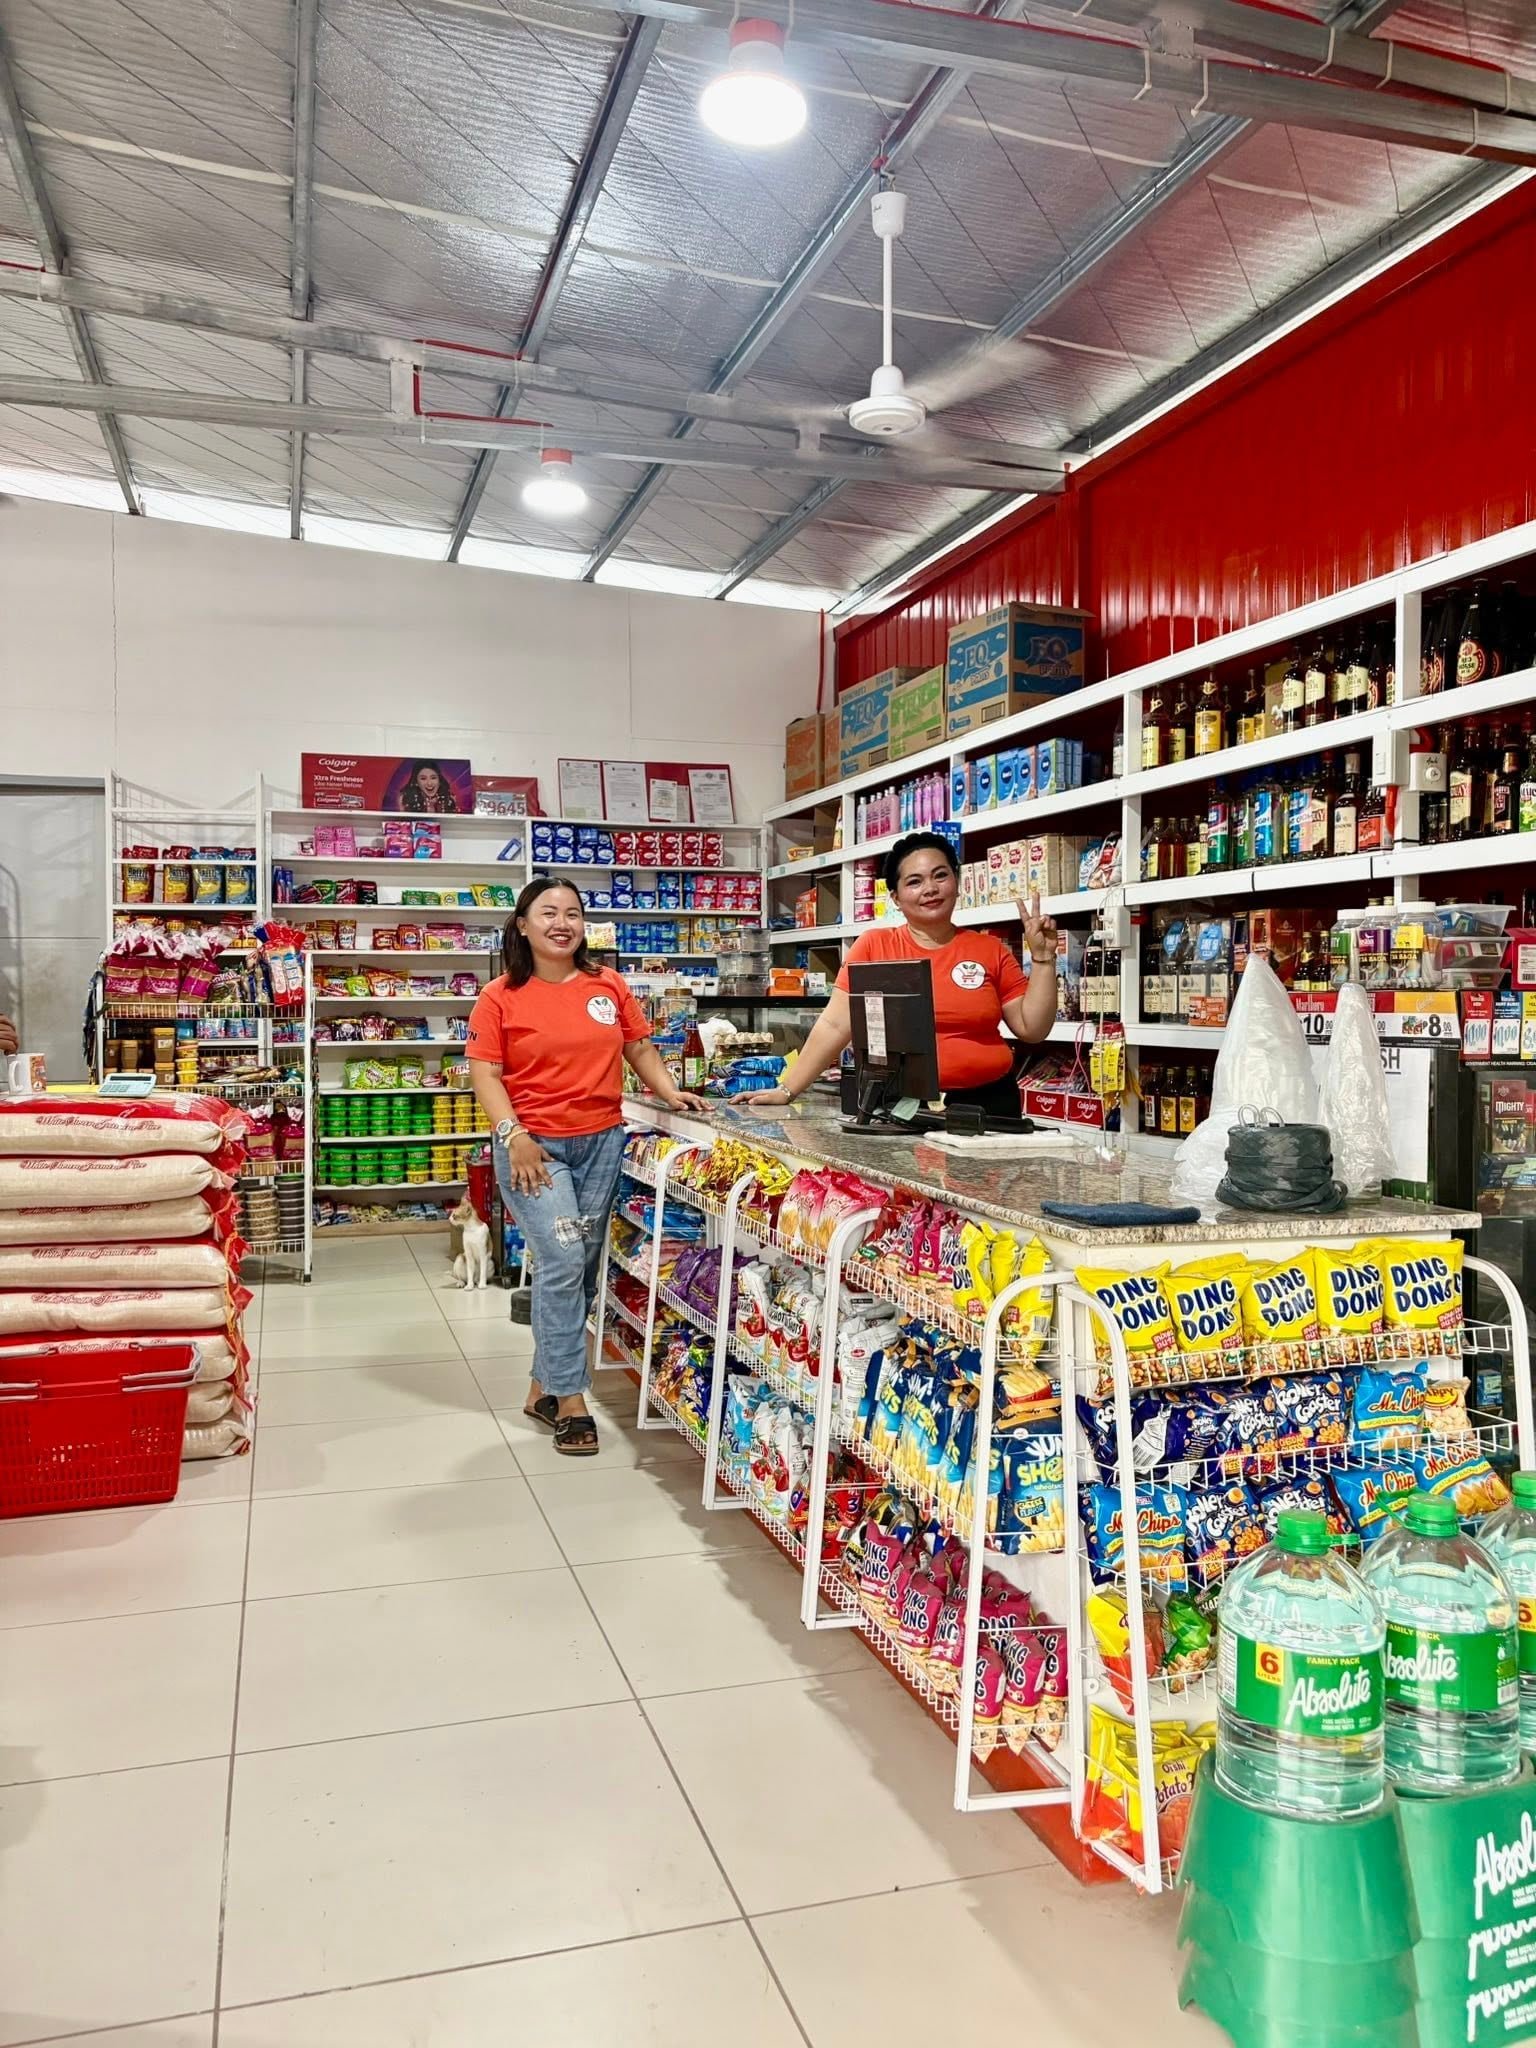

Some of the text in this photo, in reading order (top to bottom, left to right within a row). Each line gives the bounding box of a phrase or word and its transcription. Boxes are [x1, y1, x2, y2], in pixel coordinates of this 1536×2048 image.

[318, 757, 358, 768] Colgate
[330, 775, 364, 783] Freshness
[1296, 993, 1325, 1012] Marlboro
[1036, 1095, 1057, 1105] Colgate
[1077, 1101, 1098, 1112] Colgate
[1495, 1101, 1525, 1114] MIGHTY
[1331, 1264, 1380, 1292] DING
[1391, 1257, 1448, 1288] DING
[1096, 1277, 1157, 1309] DING
[1177, 1280, 1236, 1316] DING
[1254, 1267, 1306, 1305] DING
[1394, 1278, 1452, 1313] DONG
[1261, 1288, 1316, 1327] DONG
[1368, 1386, 1425, 1413] Mr. Chip
[1425, 1387, 1454, 1398] APPY
[1295, 1396, 1341, 1424] Coaster
[1238, 1412, 1276, 1441] Coaster
[1424, 1454, 1449, 1479] Mr.
[1384, 1470, 1416, 1493] Chip
[1137, 1510, 1182, 1535] Chips
[1186, 1493, 1224, 1534] Roller
[1206, 1504, 1249, 1538] Coaster
[902, 1607, 928, 1630] ONG
[1389, 1624, 1441, 1641] AMILY PACK
[1259, 1651, 1280, 1675] 6
[1306, 1655, 1361, 1665] FAMILY PACK
[1284, 1665, 1372, 1726] Absolute
[1162, 1758, 1186, 1773] Oishi
[1473, 1811, 1536, 1920] Absol
